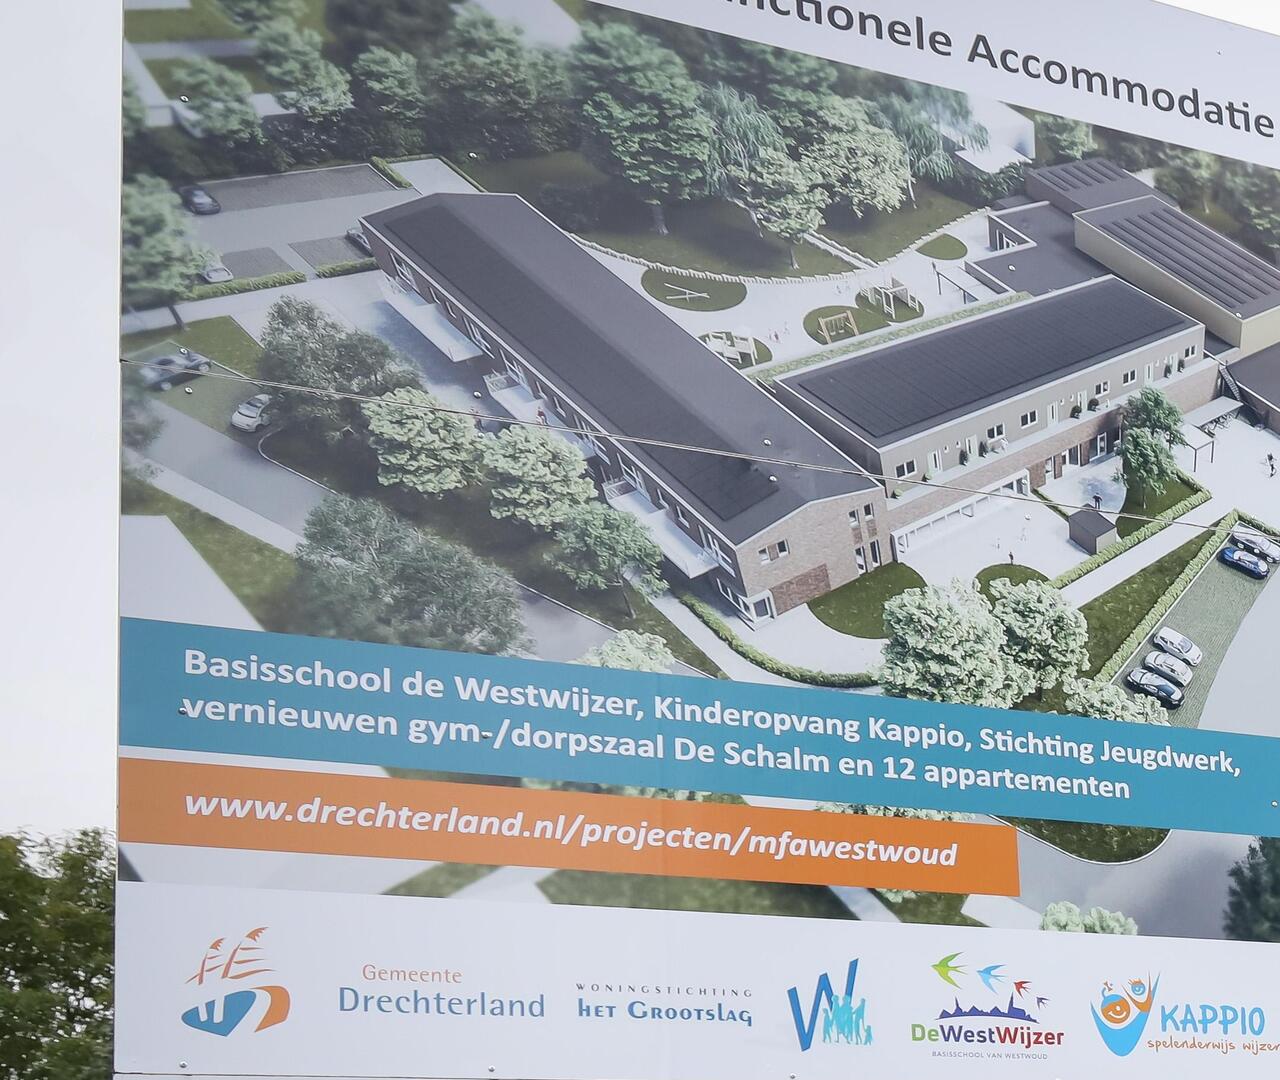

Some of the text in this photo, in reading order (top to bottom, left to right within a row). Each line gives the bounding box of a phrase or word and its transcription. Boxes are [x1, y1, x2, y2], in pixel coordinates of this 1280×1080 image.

[727, 0, 952, 56] ctionele
[967, 33, 1274, 138] Accommodatie
[183, 649, 1241, 777] Basisschool de Westwijzer, Kinderopvang Kappio, Stichting Jeugdwerk,
[182, 698, 1131, 799] vernieuwen gym-/dorpszaal De Schalm en 12 appartementen
[184, 794, 958, 868] www.drechterland.nl/projecten/mfawestwoud
[362, 964, 463, 984] Gemeente
[339, 987, 545, 1018] Drechterland
[576, 983, 752, 998] WONINGSTICHTING
[1160, 1003, 1266, 1036] KAPPIO
[911, 1023, 1065, 1049] DeWestWijzer
[1147, 1036, 1280, 1056] spelenderwijs wijzer
[932, 1050, 984, 1059] BASISSCHOOL
[1005, 1052, 1048, 1060] WESTWOUD
